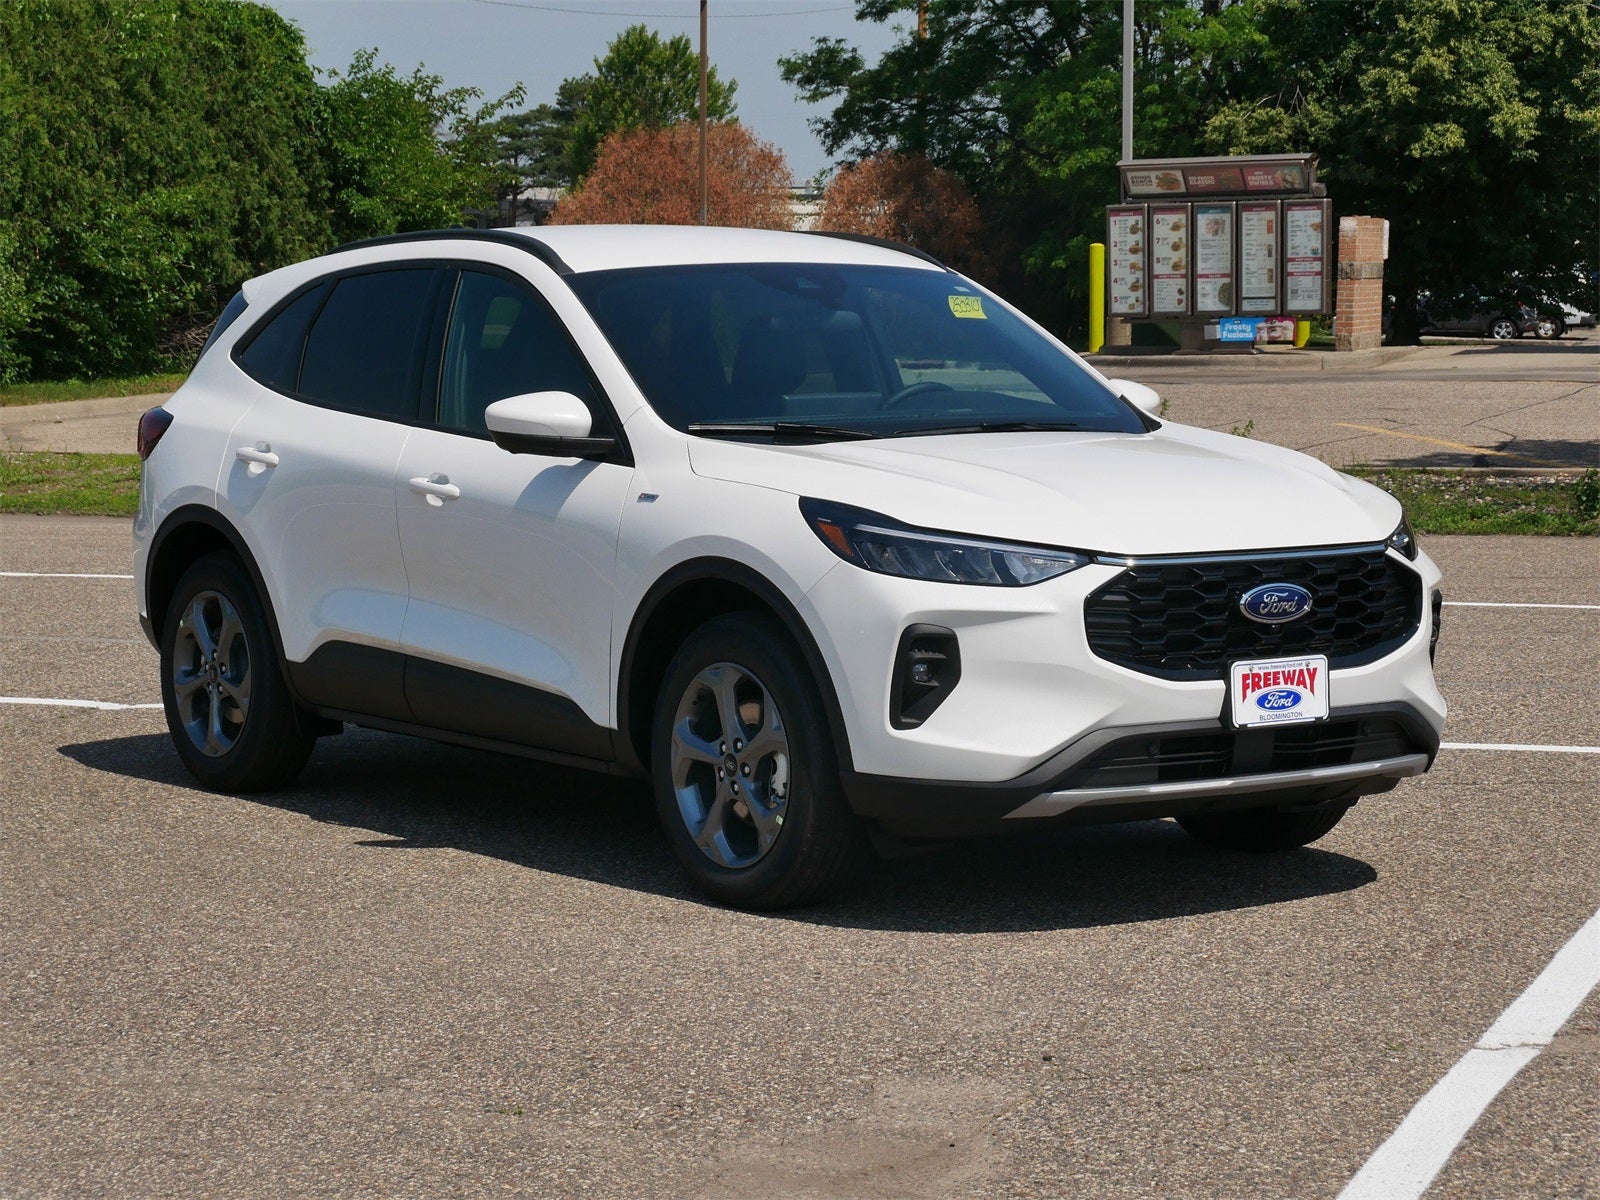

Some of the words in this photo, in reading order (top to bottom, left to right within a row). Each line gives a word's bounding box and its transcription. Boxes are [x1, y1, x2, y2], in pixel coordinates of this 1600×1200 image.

[1113, 240, 1118, 248] 2
[1155, 256, 1160, 264] 8
[1224, 323, 1252, 331] Frosty
[1222, 331, 1254, 339] Fusions
[1259, 591, 1298, 614] Ford
[1241, 667, 1318, 703] FREEWAY
[1264, 691, 1294, 708] Ford
[1259, 711, 1303, 721] BLOOMINGTON
